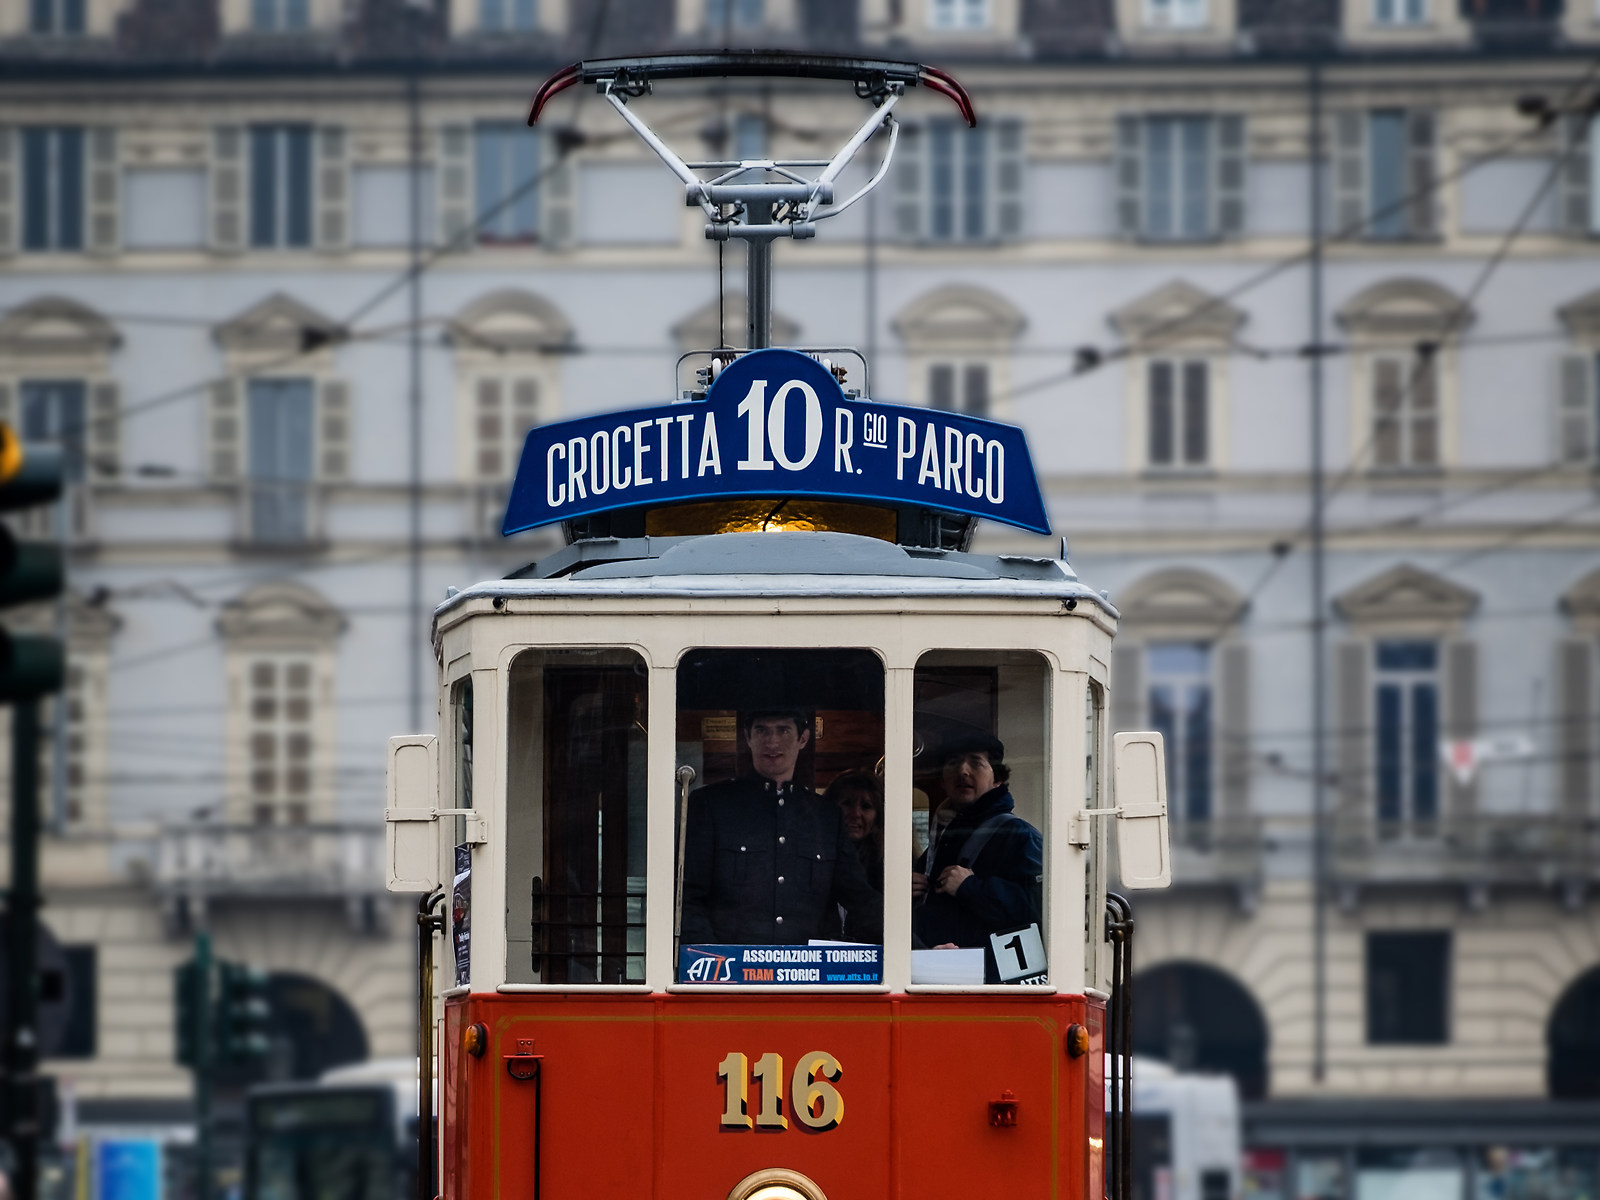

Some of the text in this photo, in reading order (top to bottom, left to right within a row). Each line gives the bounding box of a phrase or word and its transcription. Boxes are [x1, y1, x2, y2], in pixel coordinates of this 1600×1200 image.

[546, 411, 722, 508] CROCETTA
[737, 379, 823, 472] 10
[897, 416, 1005, 505] PARCO
[742, 949, 878, 963] ASSOCIAZIONE TORINESE
[1004, 934, 1028, 971] 1
[687, 957, 737, 981] ATTS
[742, 968, 879, 982] TRAM STORICI www.atts.to.it
[717, 1050, 845, 1132] 116
